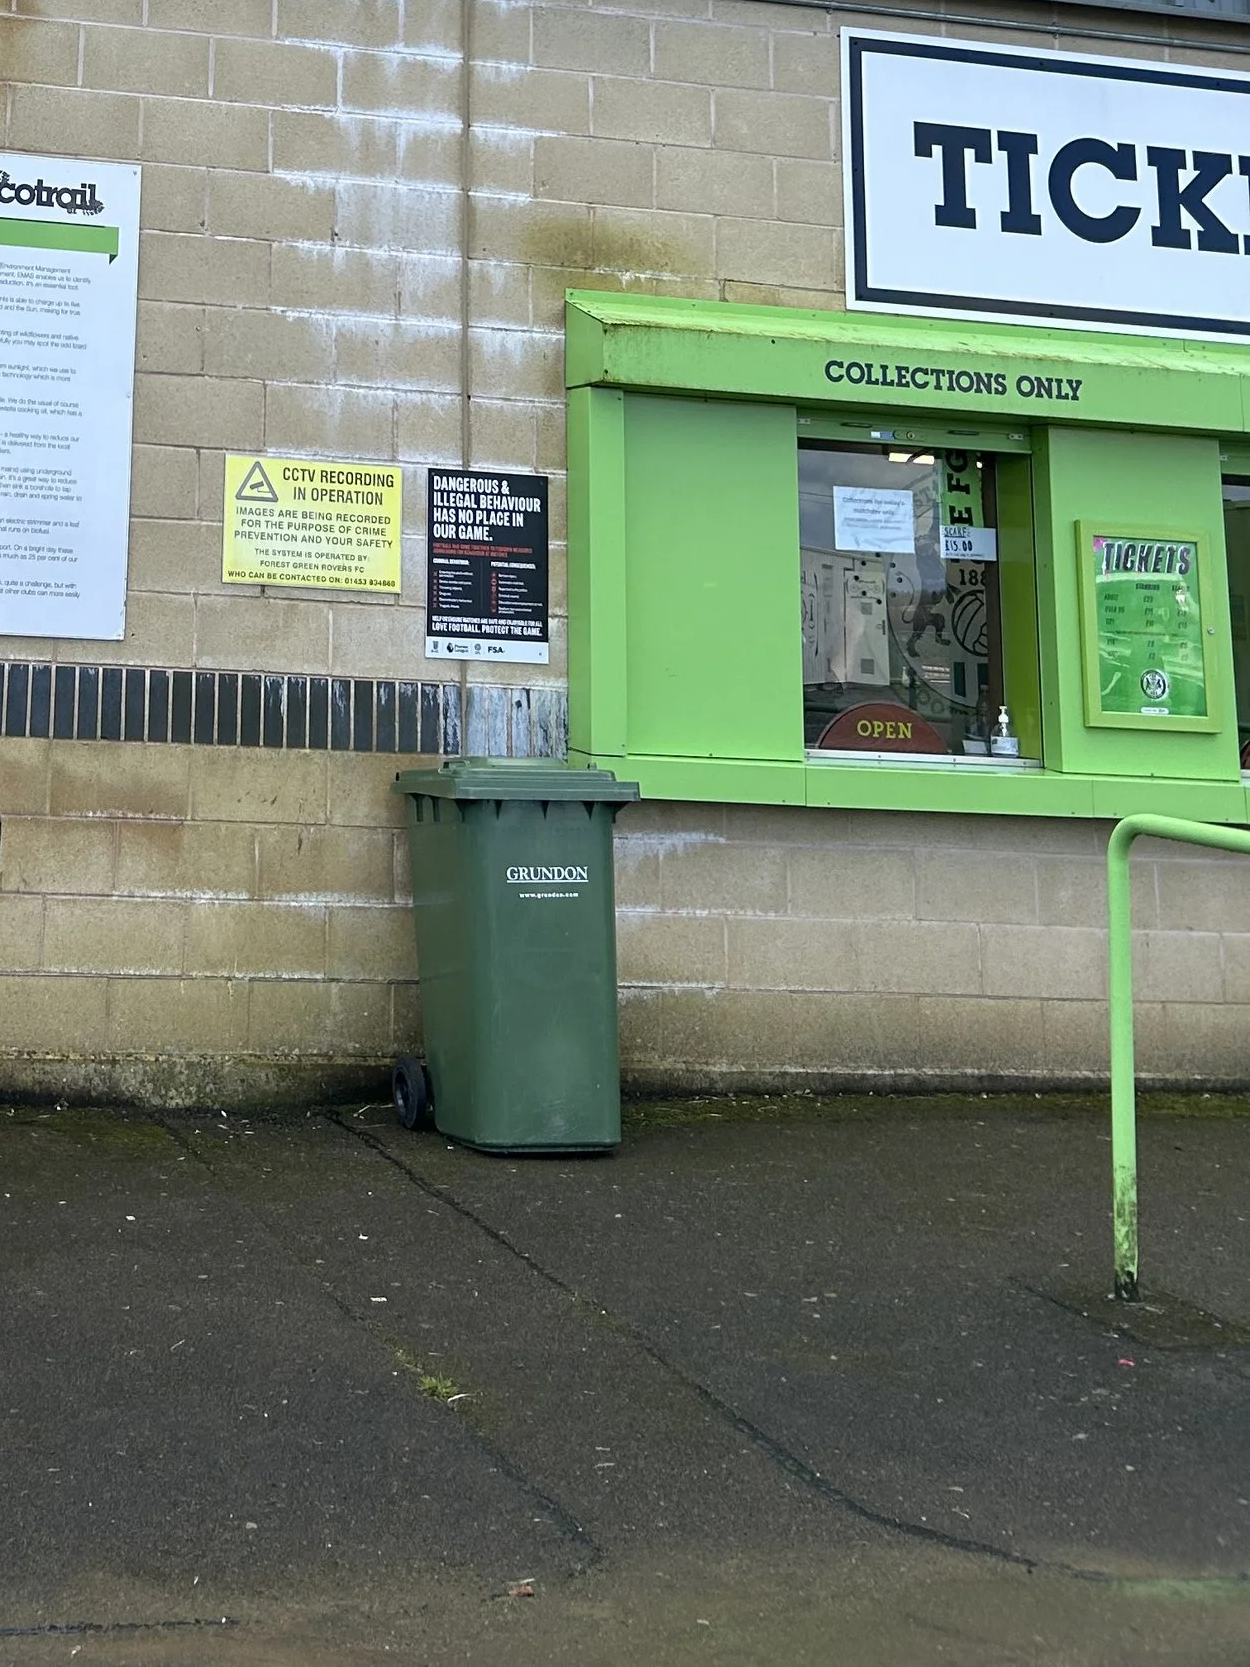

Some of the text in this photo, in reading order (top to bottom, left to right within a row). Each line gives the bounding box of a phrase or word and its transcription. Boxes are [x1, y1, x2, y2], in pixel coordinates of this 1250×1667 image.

[824, 359, 1083, 401] COLLECTIONS ONLY
[283, 467, 395, 488] CCTV RECORDING
[433, 475, 510, 495] DANGEROUS &
[293, 486, 383, 506] IN OPERATION
[433, 491, 542, 513] ILLEGAL BEHAVIOUR
[236, 506, 391, 525] IMAGES ARE BEING RECORDED
[433, 507, 524, 527] HAS NO PLACE IN
[241, 518, 387, 537] FOR THE PURPOSE OF CRIME
[433, 523, 494, 542] OUR GAME.
[234, 531, 394, 549] PREVENTION AND YOUR SAFETY
[945, 540, 973, 552] £15.00
[255, 548, 270, 556] THE
[271, 549, 303, 558] SYSTEM
[314, 552, 356, 562] OPERATED
[1103, 541, 1191, 575] TICKETS
[260, 560, 365, 574] FOREST GREEN ROVERS FC
[228, 570, 247, 578] WHO
[248, 571, 265, 579] CAN
[267, 572, 278, 580] BE
[279, 573, 327, 583] CONTACTED
[329, 576, 343, 584] ON:
[344, 577, 367, 586] 01453
[432, 621, 448, 632] LOVE
[448, 623, 481, 634] FOOTBALL.
[481, 625, 510, 635] PROTECT
[510, 626, 523, 636] THE
[523, 627, 543, 637] GAME.
[487, 645, 504, 654] FSA
[856, 719, 913, 739] OPEN
[506, 866, 589, 881] GRUNDON
